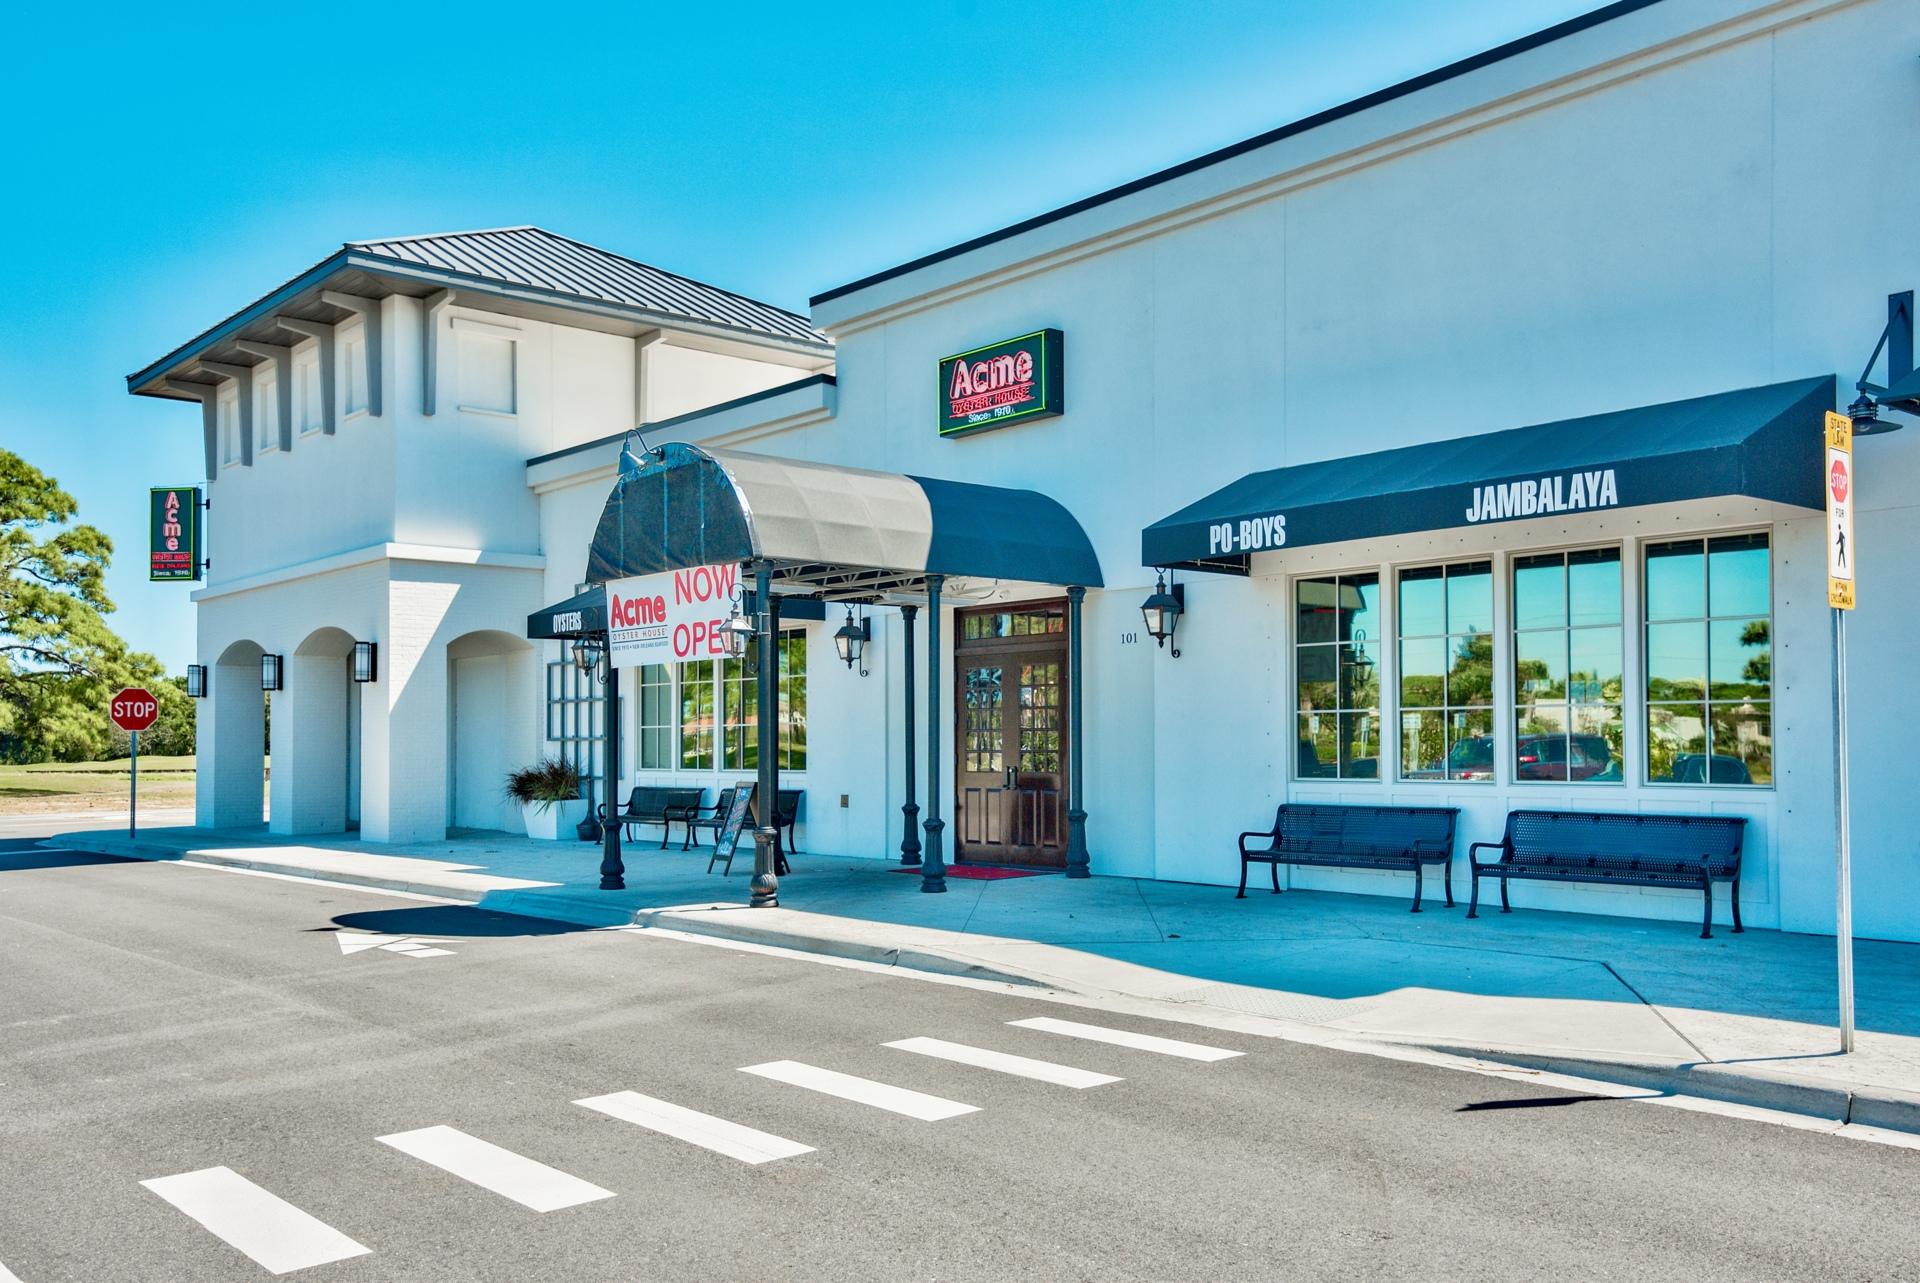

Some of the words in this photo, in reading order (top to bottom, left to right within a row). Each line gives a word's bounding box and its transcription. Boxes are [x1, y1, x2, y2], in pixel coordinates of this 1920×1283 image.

[950, 350, 1033, 399] Acme
[952, 396, 992, 414] OYSTER
[995, 386, 1030, 405] HOUSE
[1830, 417, 1848, 434] STATE
[1833, 430, 1845, 447] LAW
[1831, 472, 1847, 490] STOP
[1465, 468, 1618, 523] JAMBALAYA
[163, 491, 181, 551] Acme
[1209, 514, 1286, 555] PO-BOYS
[674, 561, 737, 606] NOW
[552, 611, 582, 634] OYSTERS
[610, 593, 667, 629] Acme
[612, 631, 639, 641] OYSTER
[642, 628, 665, 638] HOUSE
[1121, 632, 1137, 644] 101
[113, 701, 155, 718] STOP
